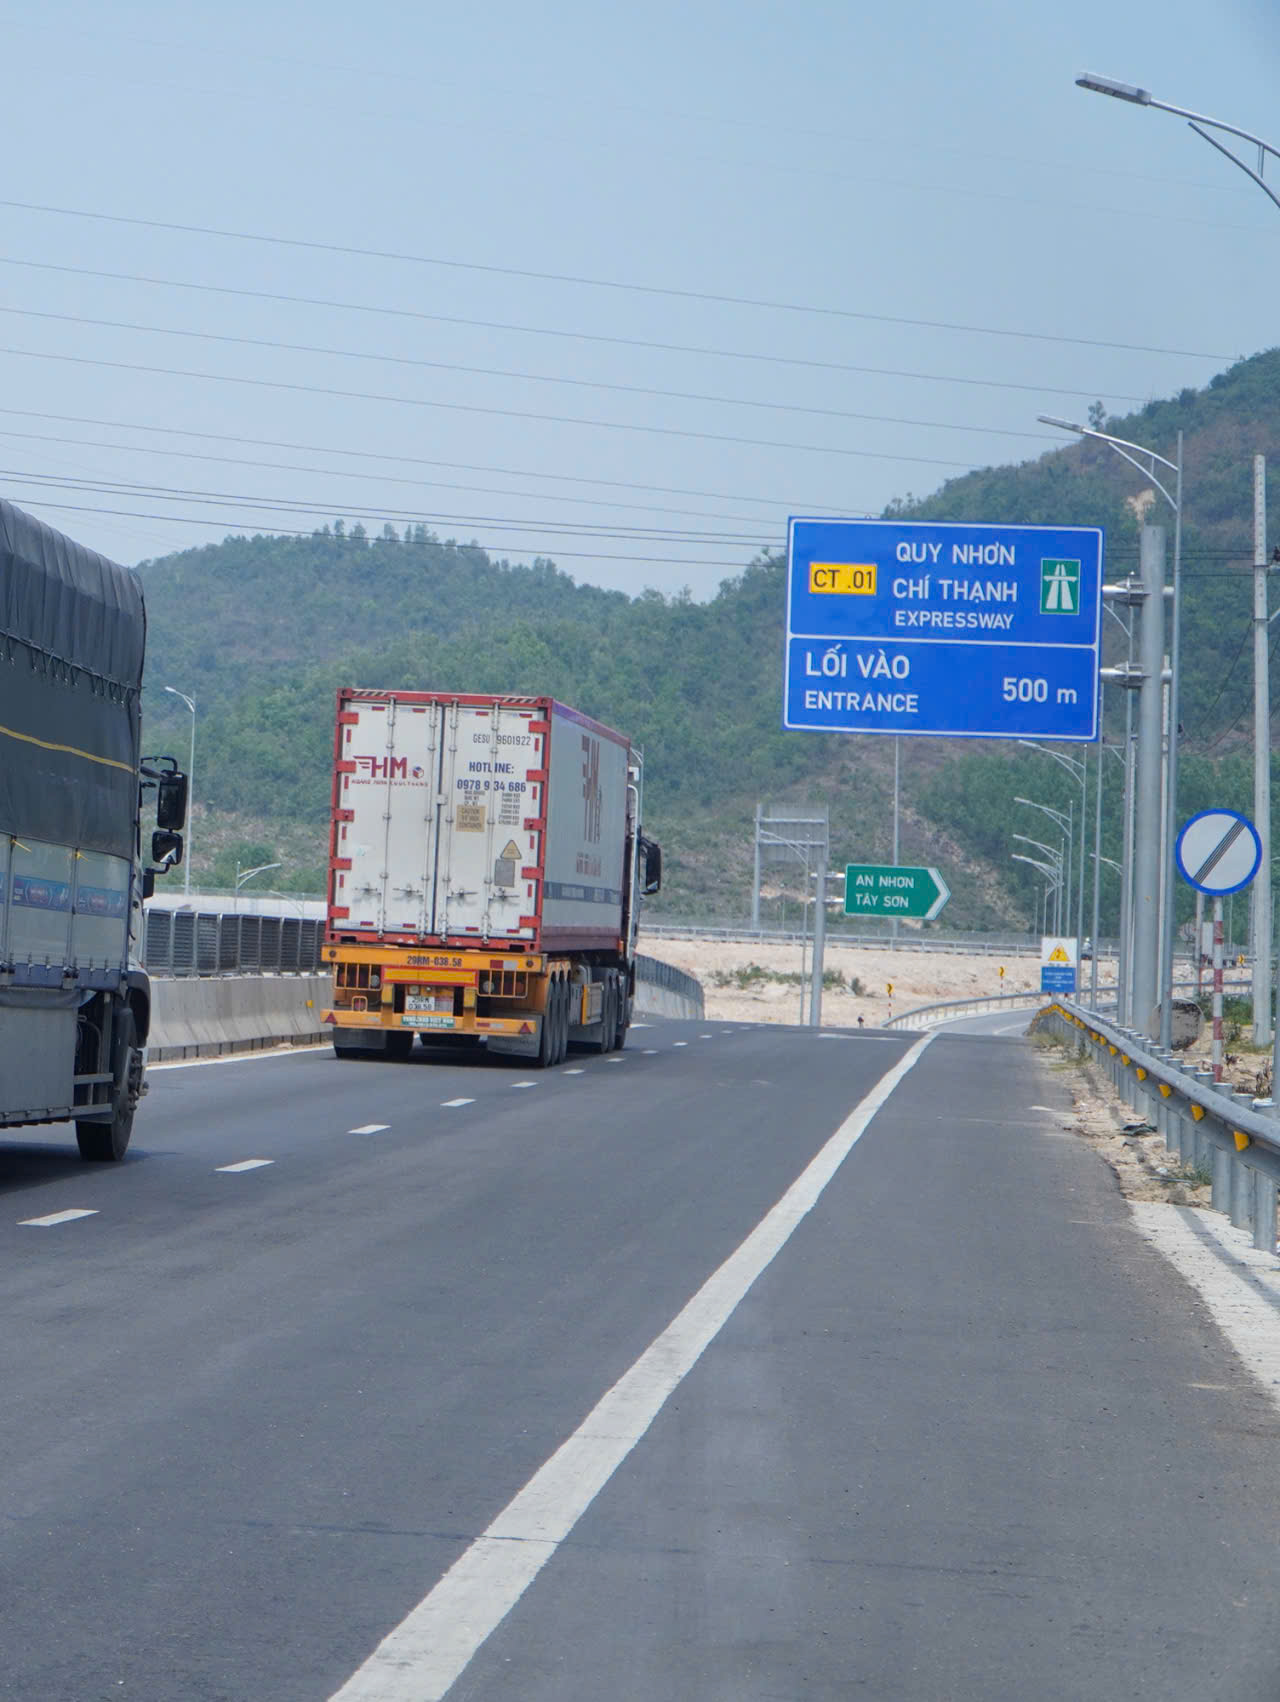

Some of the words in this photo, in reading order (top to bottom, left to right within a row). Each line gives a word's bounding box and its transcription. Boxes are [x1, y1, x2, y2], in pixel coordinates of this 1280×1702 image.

[896, 542, 942, 564] QUY
[952, 541, 1015, 566] NHƠN
[813, 569, 840, 589] CT
[893, 574, 929, 599] CHÍ
[939, 579, 1018, 603] THẠNH
[895, 610, 1014, 629] EXPRESSWAY
[806, 644, 847, 677] LỐI
[857, 649, 910, 680] VÀO
[1003, 677, 1048, 703] 500
[1057, 687, 1077, 704] m
[805, 690, 919, 713] ENTRANCE
[473, 733, 491, 744] GESU
[469, 761, 515, 774] HOTLINE:
[457, 779, 481, 791] 0978
[855, 874, 874, 887] AN
